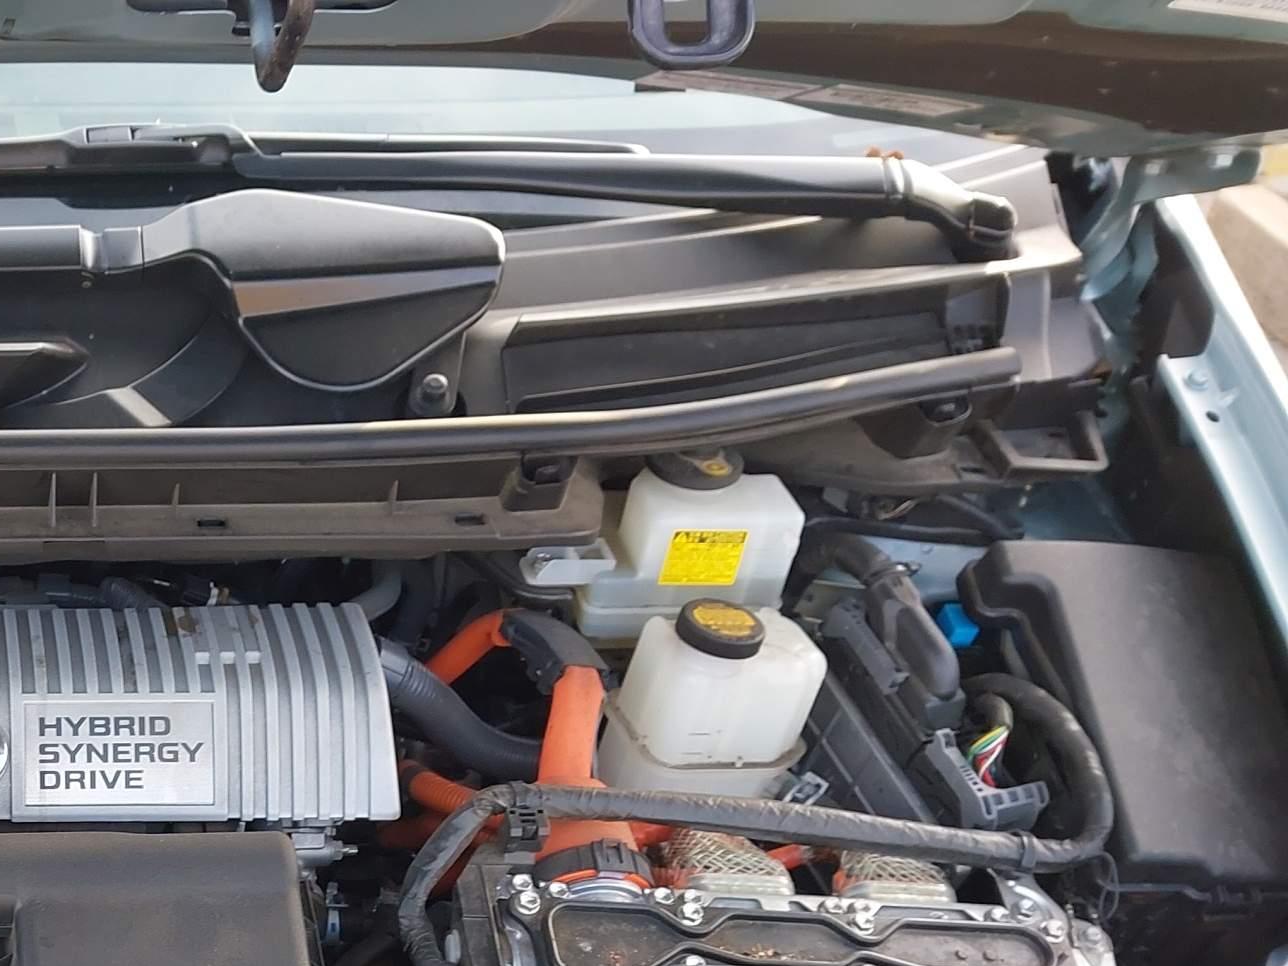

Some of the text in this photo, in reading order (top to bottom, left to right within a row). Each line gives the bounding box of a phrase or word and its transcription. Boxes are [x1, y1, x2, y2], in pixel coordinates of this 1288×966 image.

[39, 716, 171, 737] HYBRID
[38, 742, 204, 764] SYNERGY
[39, 770, 144, 790] DRIVE
